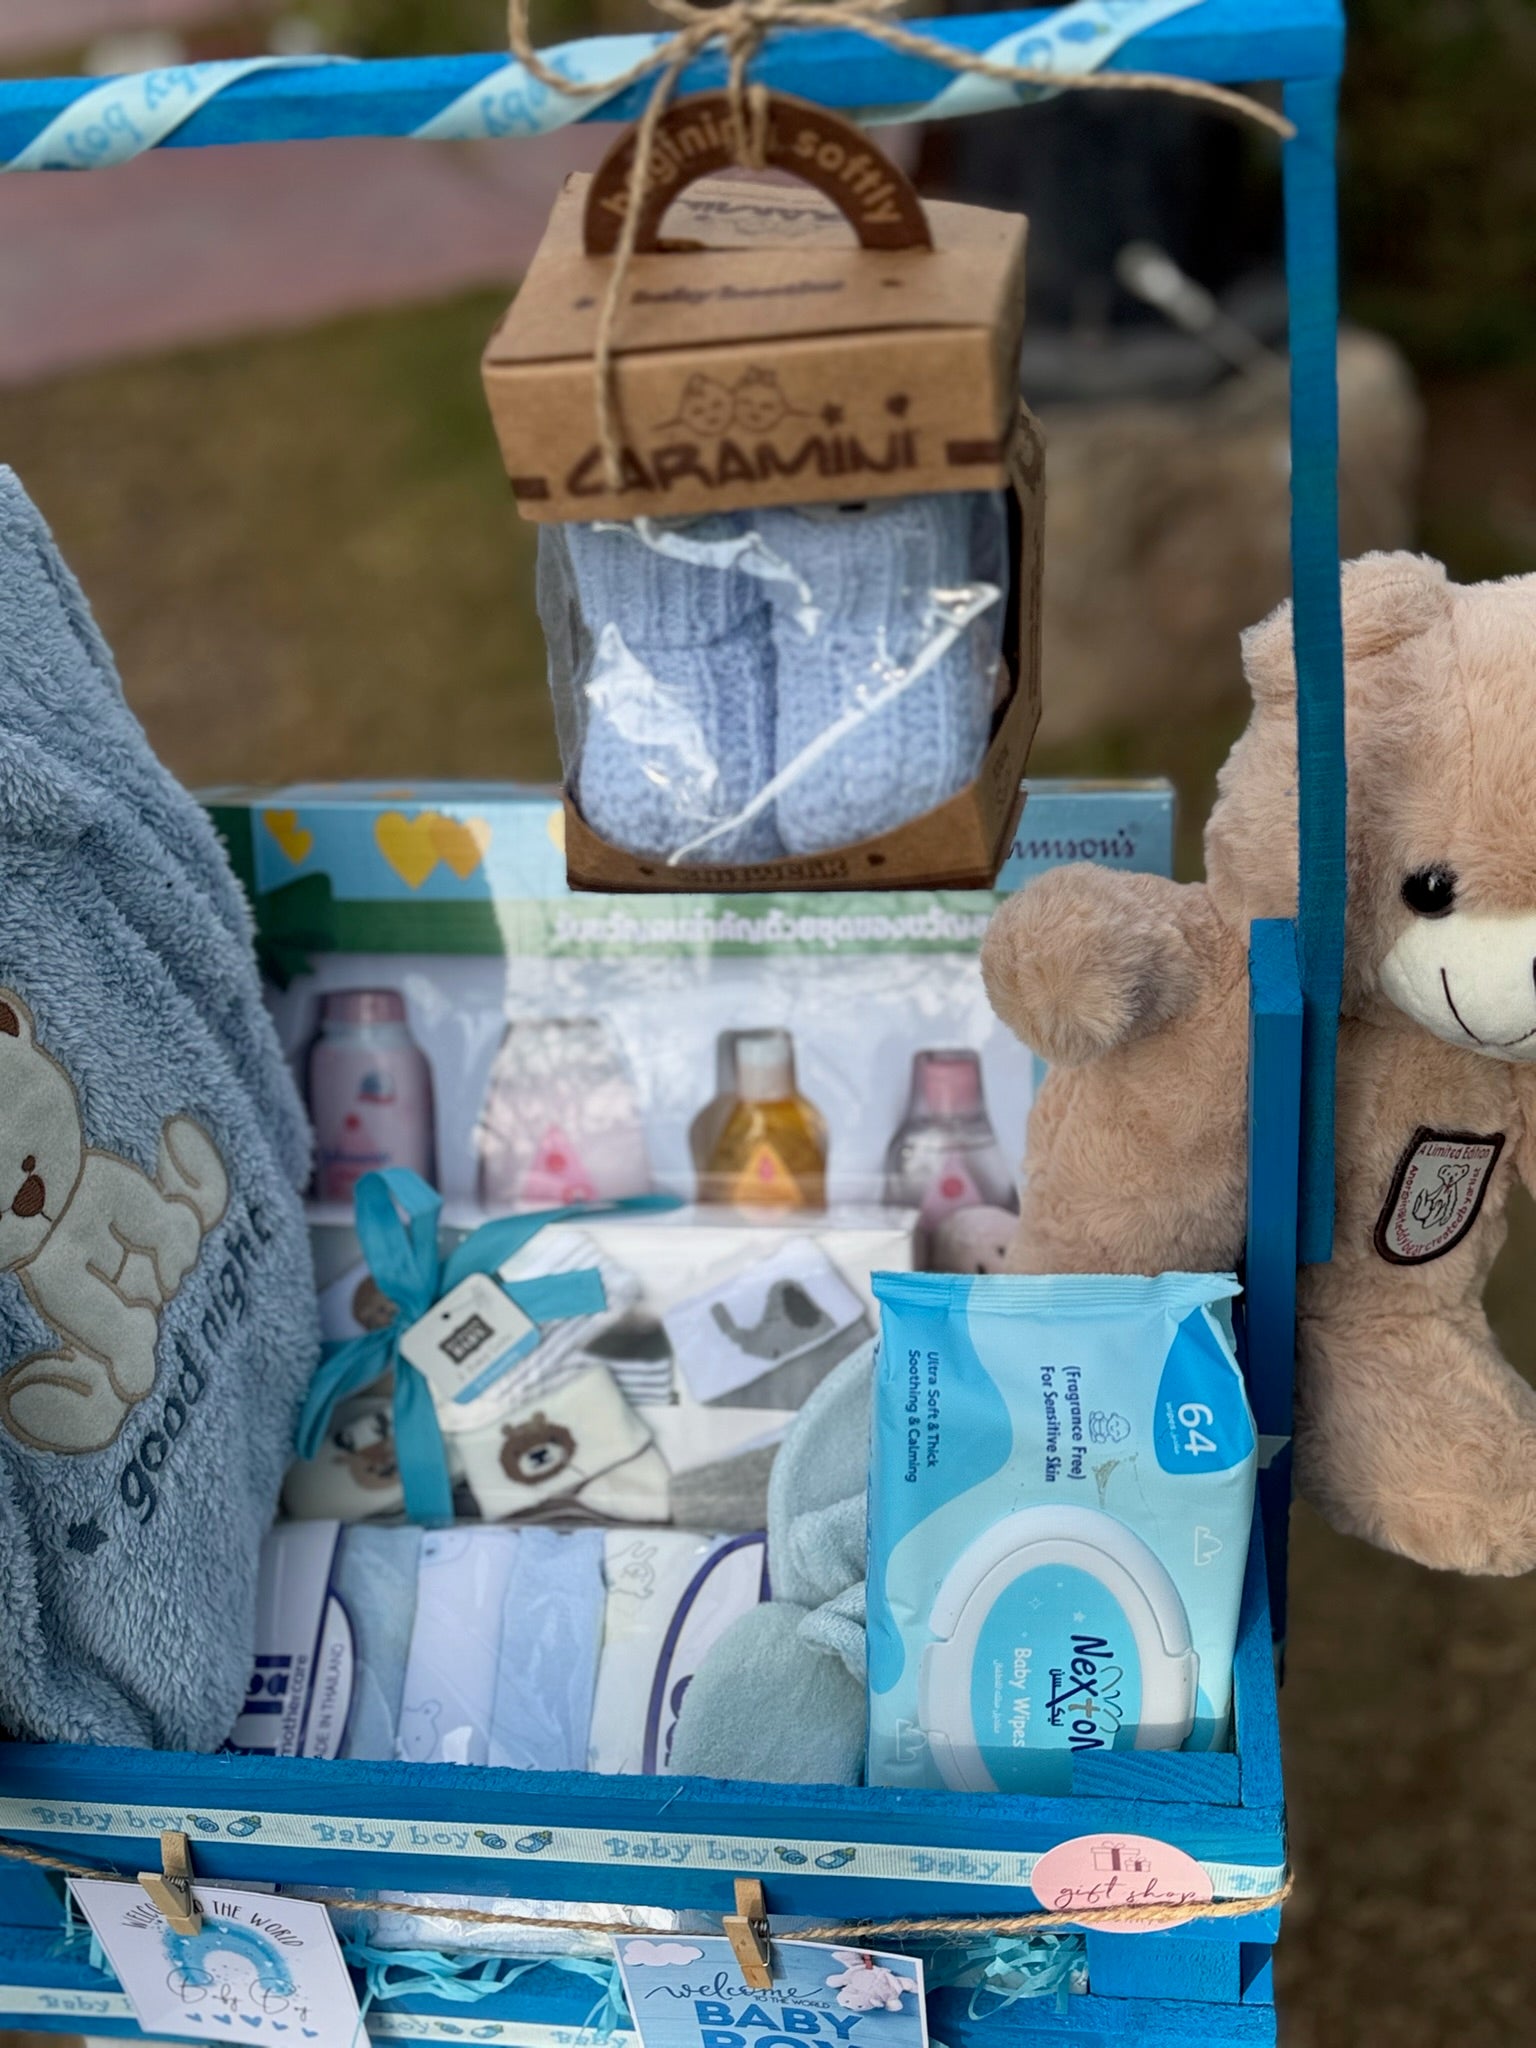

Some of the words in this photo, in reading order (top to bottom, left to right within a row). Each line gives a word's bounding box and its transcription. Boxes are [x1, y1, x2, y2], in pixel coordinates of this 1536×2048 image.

[793, 129, 902, 223] softly
[566, 430, 917, 497] CARAMINI
[905, 1349, 921, 1413] Soothing
[927, 1351, 939, 1385] Ultra
[1040, 1366, 1055, 1388] For
[927, 1389, 940, 1420] Soft
[1062, 1366, 1082, 1441] (Fragrance
[120, 1333, 205, 1525] good
[908, 1417, 921, 1426] &
[927, 1423, 940, 1431] &
[1043, 1391, 1061, 1453] Sensitive
[1178, 1403, 1217, 1456] 64
[905, 1428, 921, 1483] Calming
[927, 1434, 940, 1468] Thick
[1067, 1446, 1087, 1480] Free)
[1045, 1456, 1061, 1482] Skin
[322, 1642, 345, 1709] THAILAND
[1009, 1647, 1032, 1690] Baby
[282, 1655, 308, 1755] mothercare
[319, 1714, 332, 1728] IN
[1008, 1696, 1031, 1748] Wipes
[32, 1806, 112, 1832] Baby
[124, 1810, 183, 1831] boy
[312, 1822, 395, 1848] Baby
[408, 1826, 469, 1849] boy
[604, 1837, 692, 1862] Baby
[706, 1840, 769, 1865] boy
[910, 1853, 1001, 1880] Baby
[1054, 1876, 1125, 1907] gift
[1125, 1878, 1196, 1905] shop
[212, 1900, 243, 1920] THE
[250, 1912, 304, 1947] WORLD
[644, 1971, 824, 2001] welcome
[753, 1994, 769, 2002] TO
[769, 1995, 790, 2005] THE
[791, 1997, 831, 2010] WORLD
[694, 2000, 863, 2040] BABY
